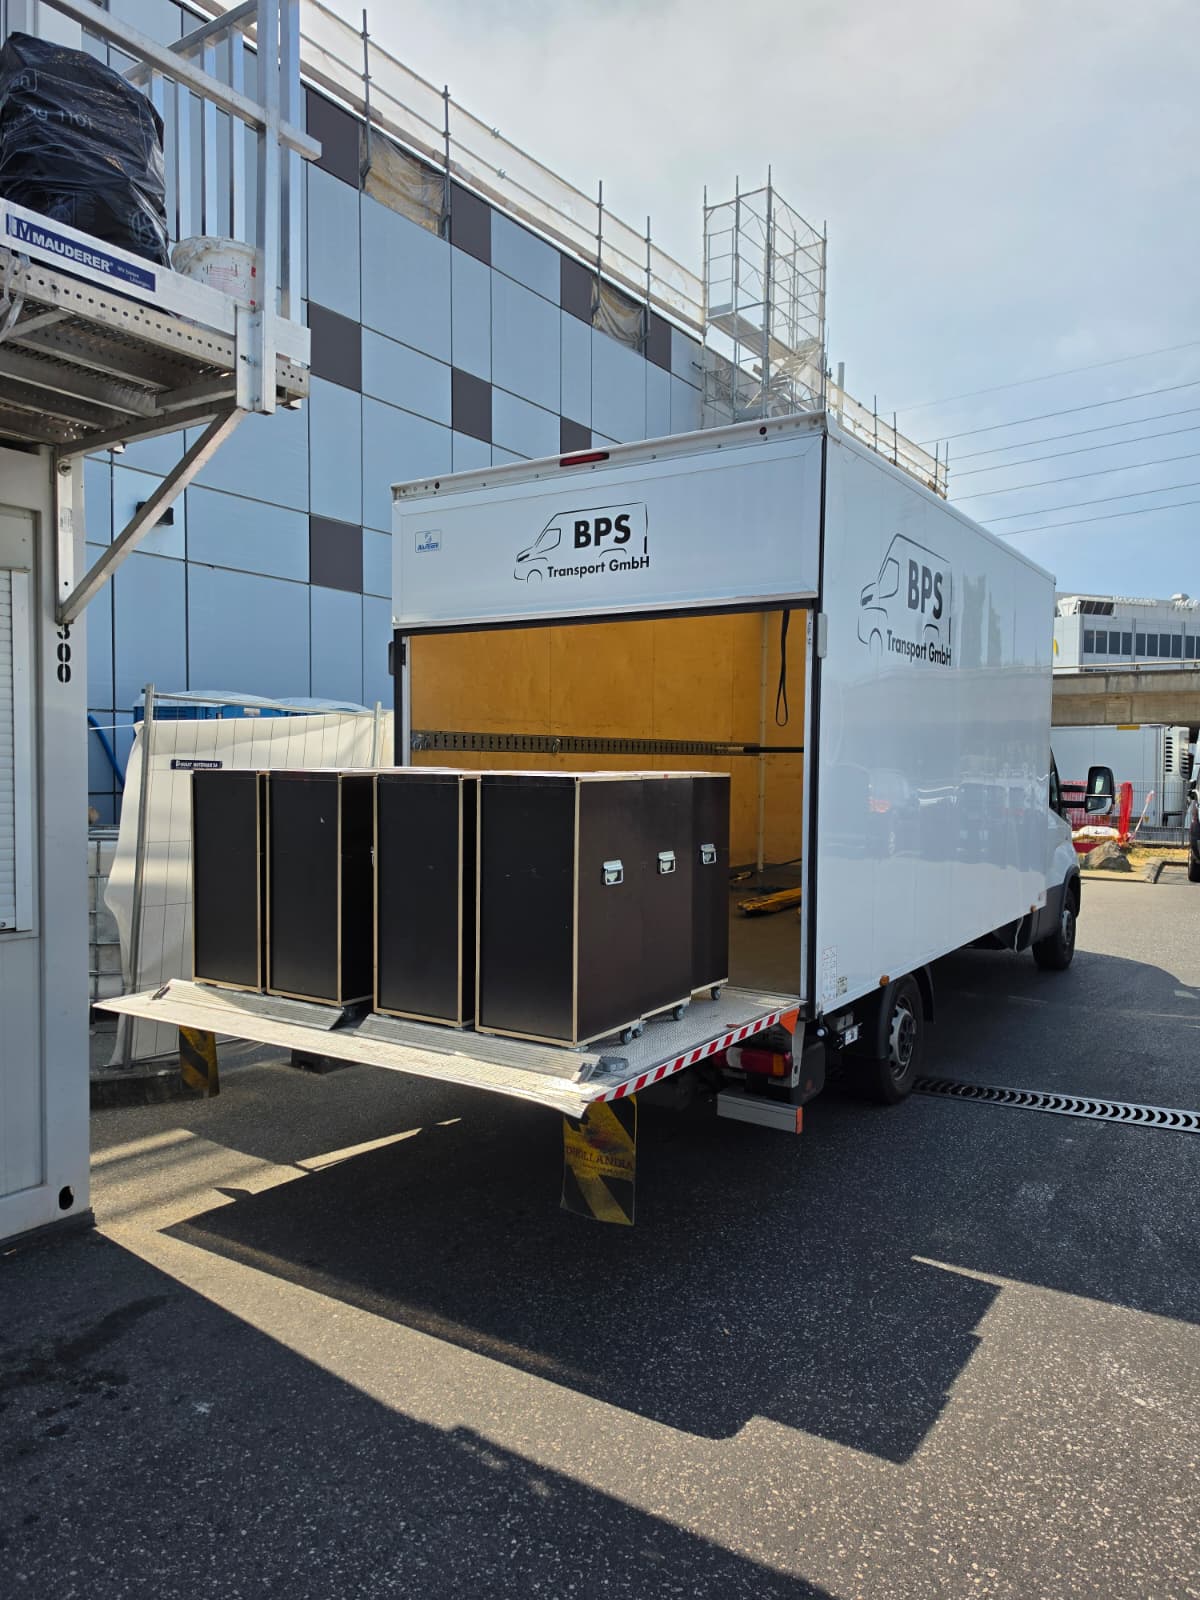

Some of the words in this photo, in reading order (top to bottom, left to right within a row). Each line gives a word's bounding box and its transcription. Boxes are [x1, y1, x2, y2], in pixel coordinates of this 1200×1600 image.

[574, 514, 632, 549] BPS
[547, 561, 605, 579] Transport
[608, 556, 650, 571] GmbH
[908, 558, 943, 620] BPS
[887, 629, 927, 663] Transport
[928, 642, 951, 666] GmbH
